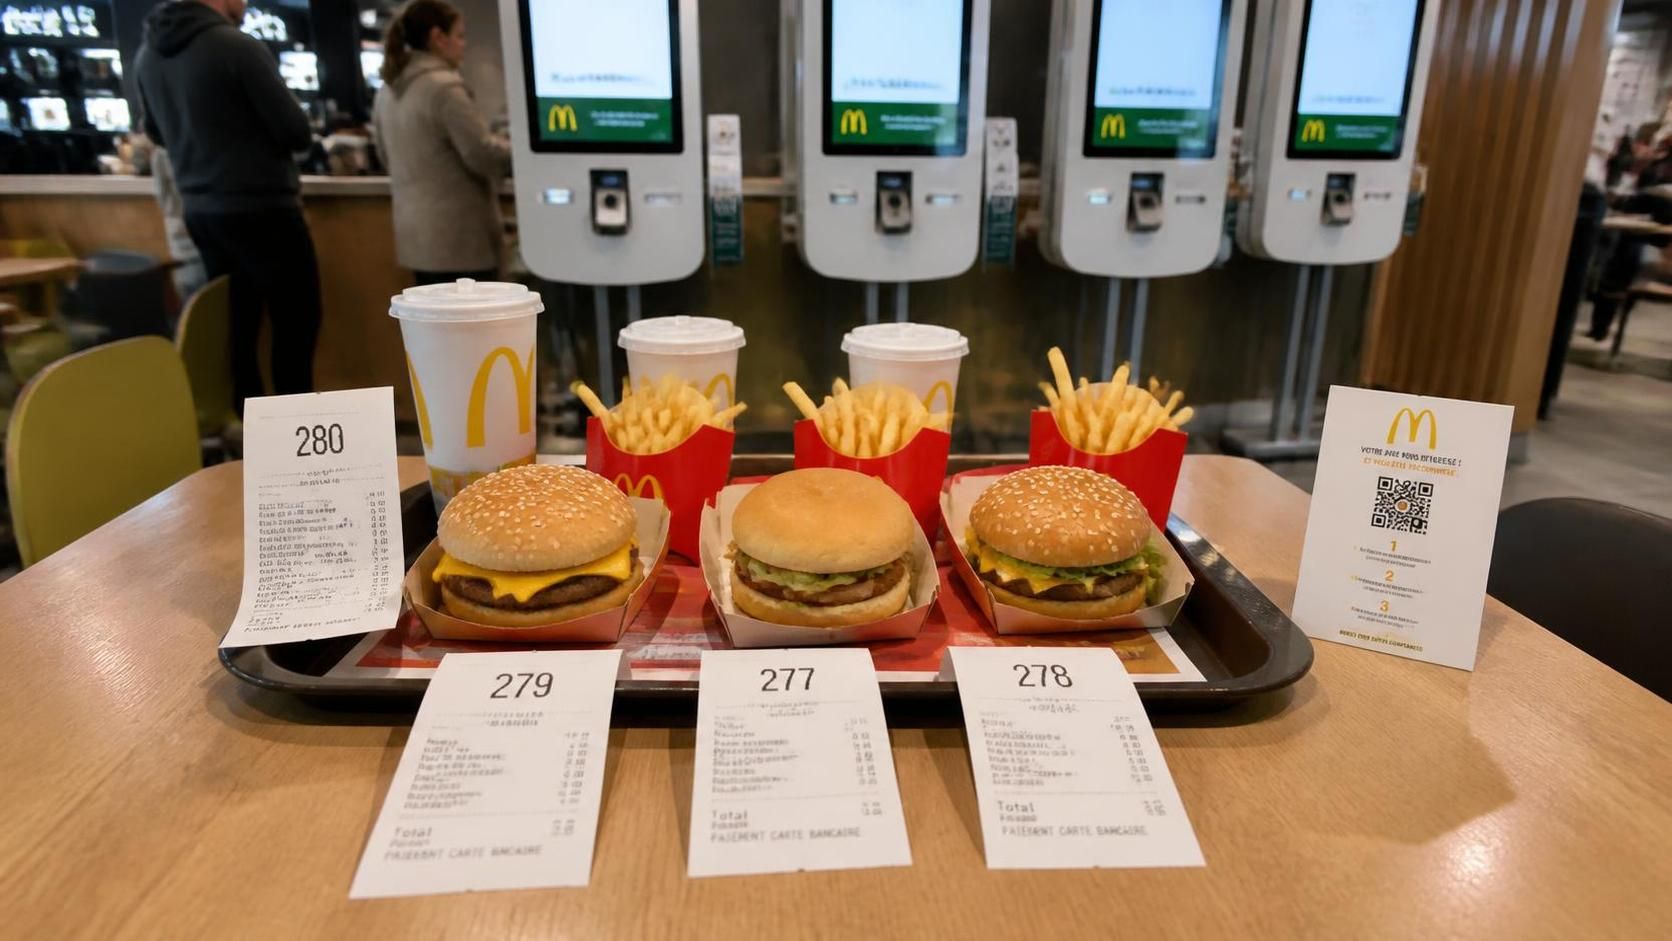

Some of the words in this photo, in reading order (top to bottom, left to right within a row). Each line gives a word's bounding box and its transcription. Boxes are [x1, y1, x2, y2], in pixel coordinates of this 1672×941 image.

[1386, 407, 1438, 451] M
[295, 423, 345, 458] 280
[1391, 540, 1398, 553] 1
[1385, 569, 1395, 583] 2
[1379, 599, 1390, 613] 3
[760, 667, 815, 692] 277
[1013, 664, 1073, 688] 278
[490, 672, 554, 699] 279
[997, 800, 1035, 813] Total
[711, 810, 748, 821] Total
[395, 826, 433, 838] Total
